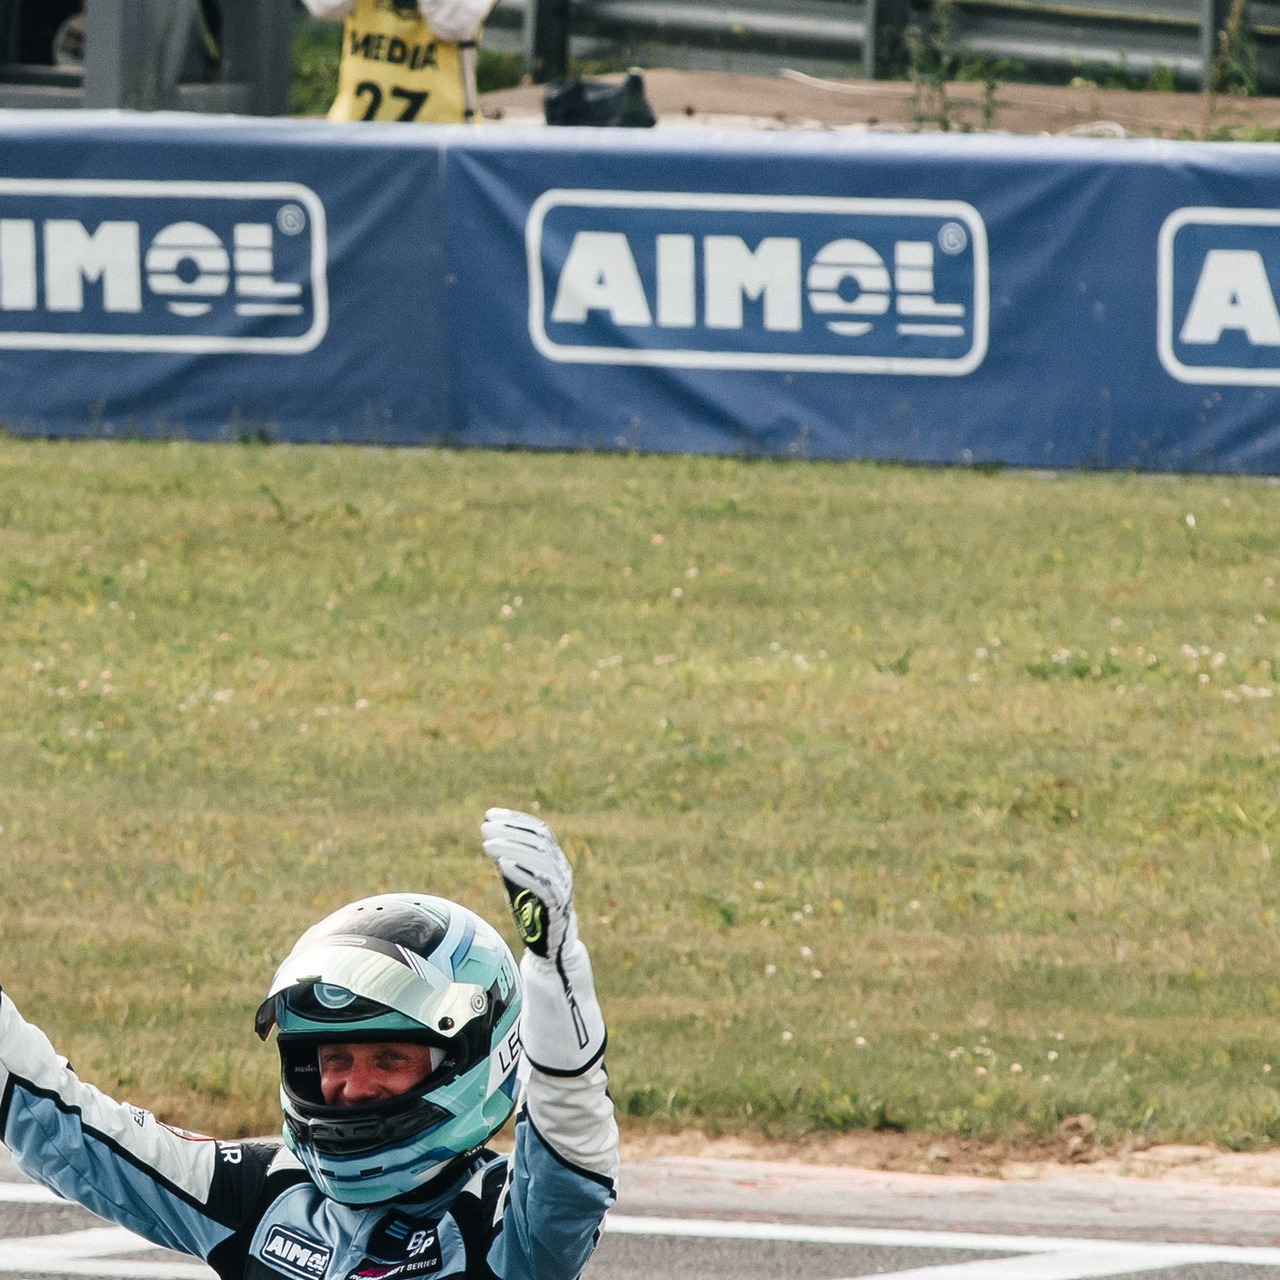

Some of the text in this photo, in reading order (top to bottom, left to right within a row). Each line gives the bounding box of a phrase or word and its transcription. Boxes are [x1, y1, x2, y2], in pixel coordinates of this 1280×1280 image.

[350, 30, 438, 70] MEDIA
[355, 81, 429, 122] 27
[551, 231, 965, 337] AIMOL
